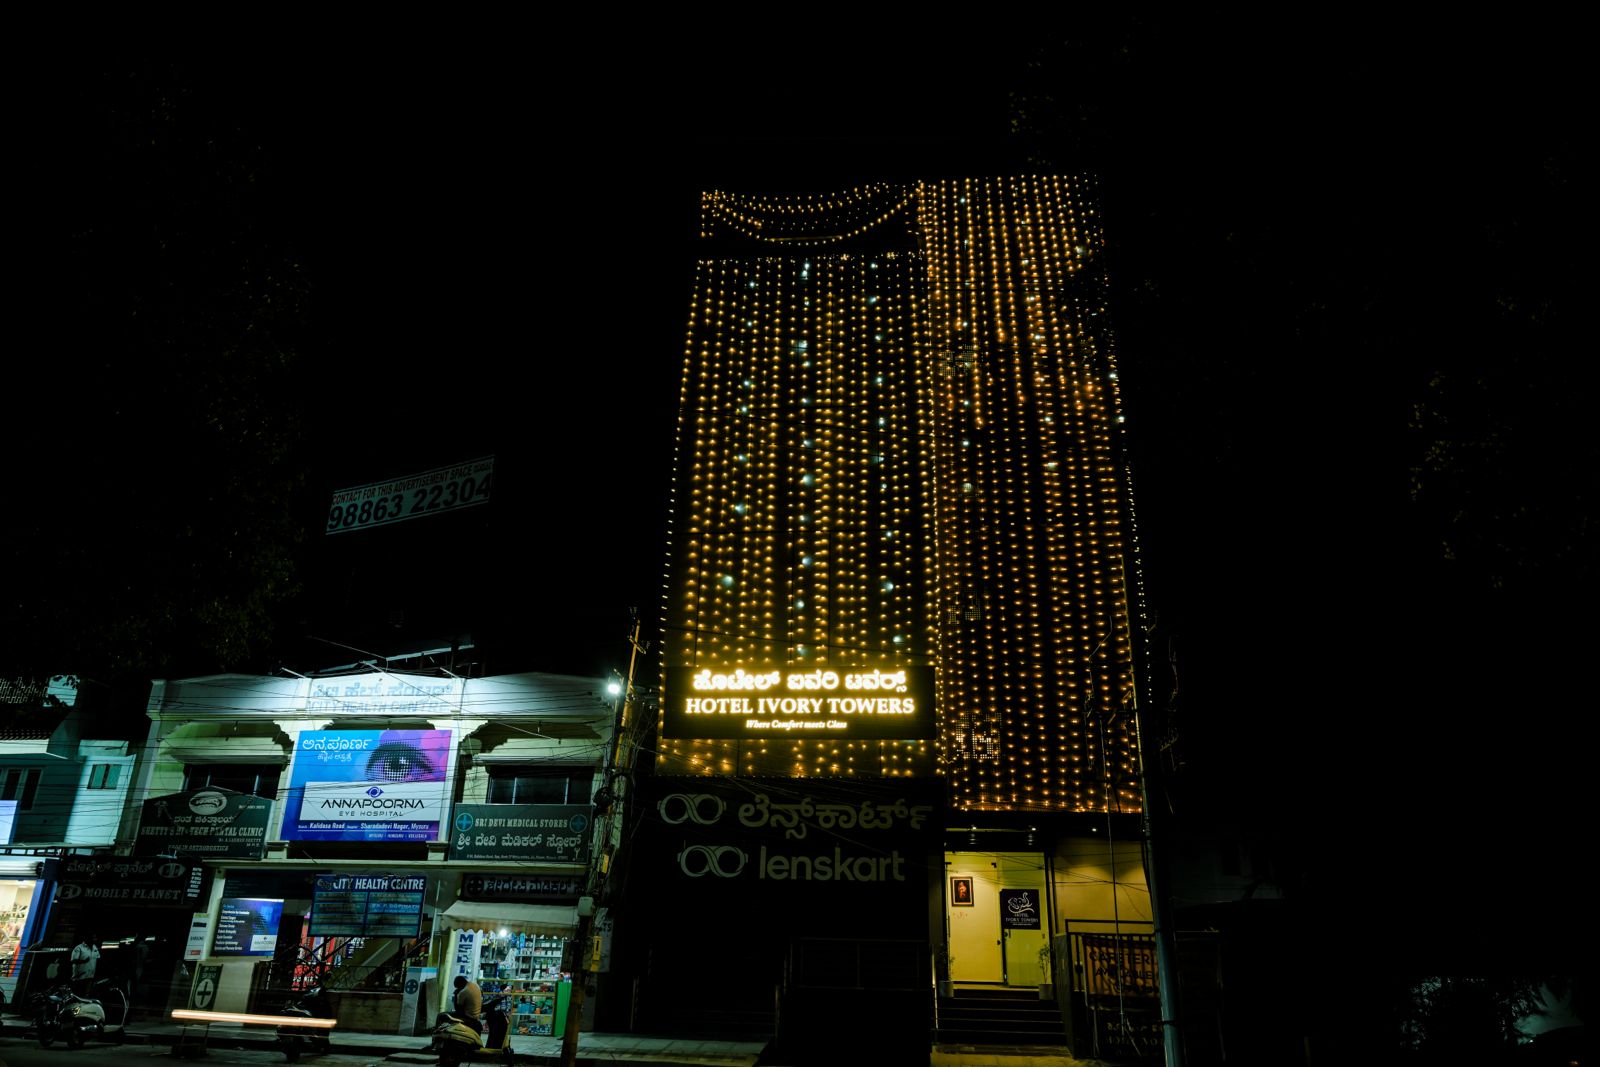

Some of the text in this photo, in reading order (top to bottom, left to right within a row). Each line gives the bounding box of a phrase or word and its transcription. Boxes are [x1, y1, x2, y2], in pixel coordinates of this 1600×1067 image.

[332, 491, 361, 505] CONTACT
[363, 487, 376, 499] FOR
[377, 484, 393, 497] THIS
[394, 472, 449, 493] ADVERTISEMENT
[451, 465, 473, 480] SPACE
[328, 473, 492, 530] 98863 22304
[685, 697, 915, 715] HOTEL IVORY TOWERS
[746, 719, 847, 731] Where Comfort meets Class
[321, 799, 424, 809] ANNAPOORNA
[474, 818, 568, 829] SRI DEVI MEDICAL STORES
[239, 827, 264, 837] CLINIC
[475, 833, 497, 847] ದೇವಿ
[501, 833, 542, 847] ಮೆಡಿಕಲ್
[758, 845, 904, 881] lenskart
[333, 878, 424, 890] CITY HEALTH CENTRE
[84, 887, 182, 900] MOBILE PLANET
